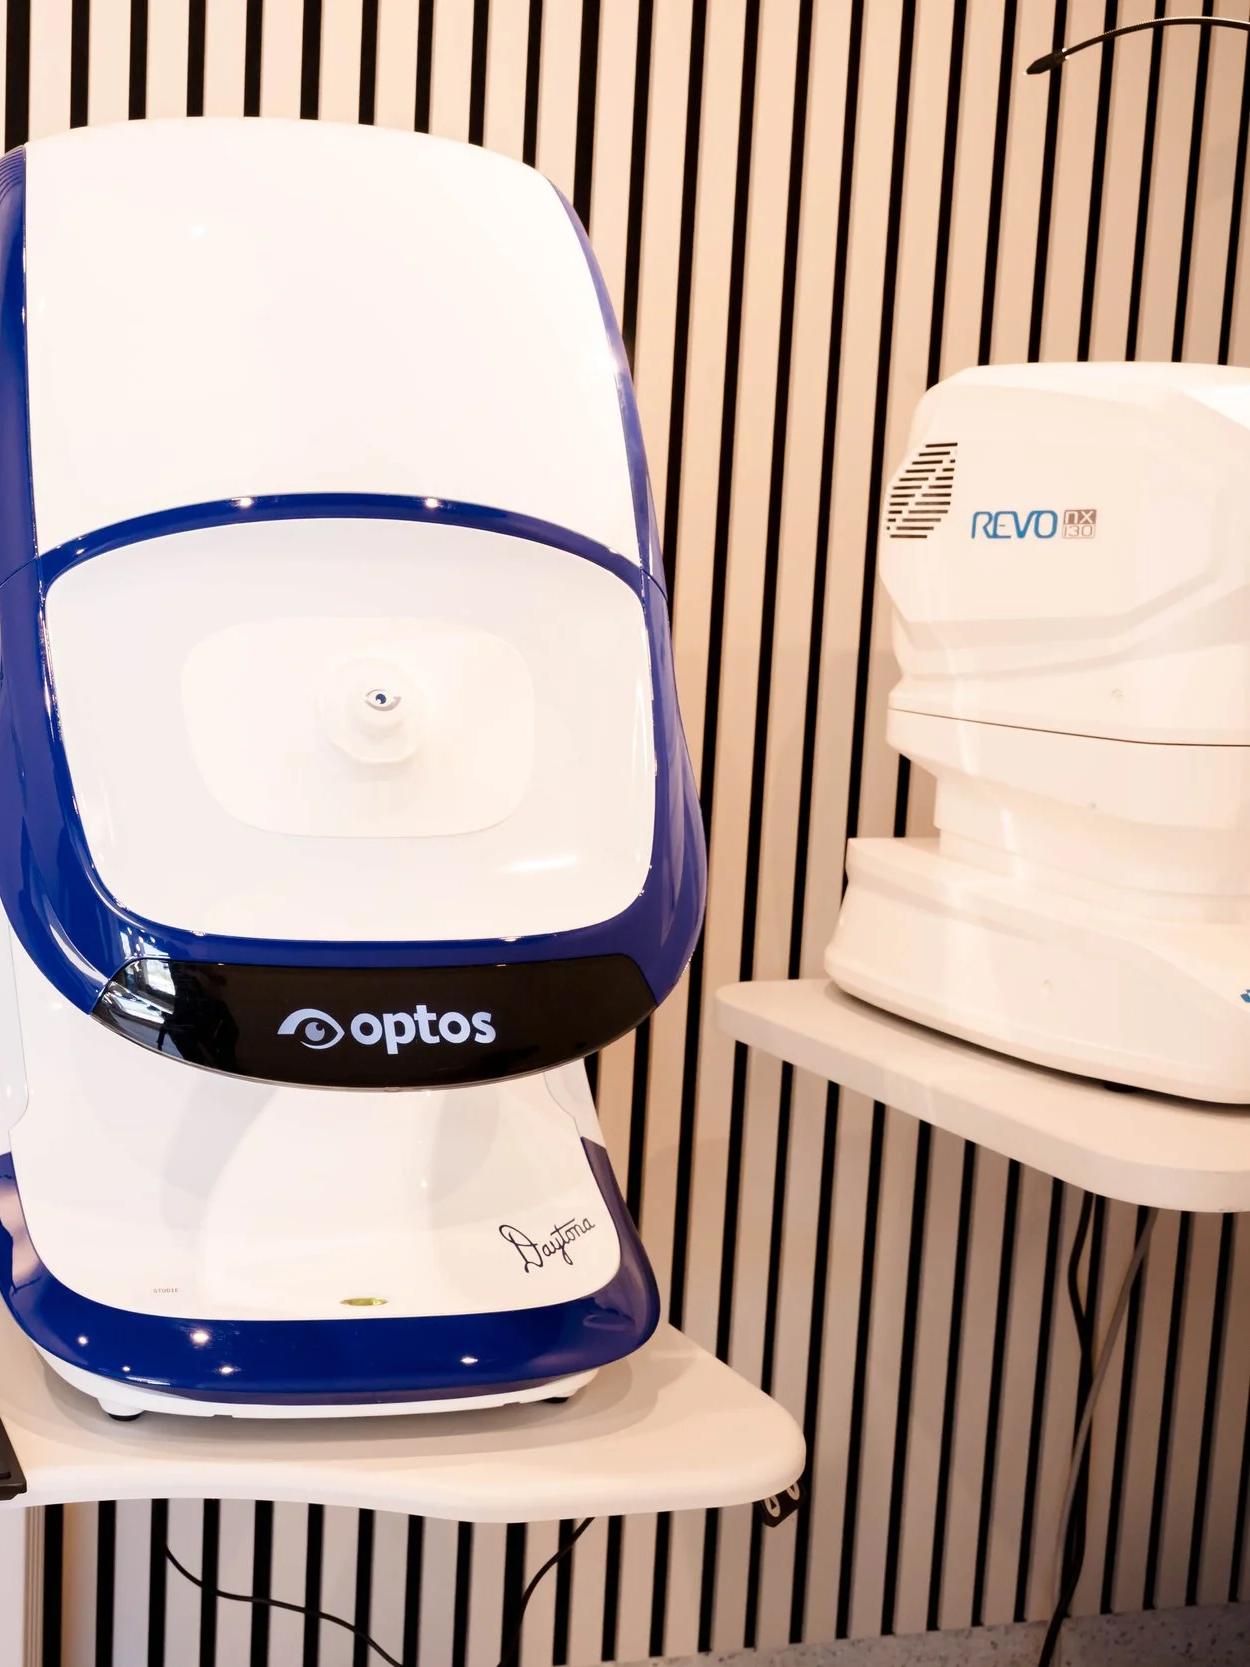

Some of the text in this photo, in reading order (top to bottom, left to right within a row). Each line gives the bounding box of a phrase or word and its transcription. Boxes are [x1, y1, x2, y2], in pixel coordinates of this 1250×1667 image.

[971, 509, 1058, 539] REVO
[350, 1004, 496, 1055] optos
[498, 1217, 595, 1273] Daytona
